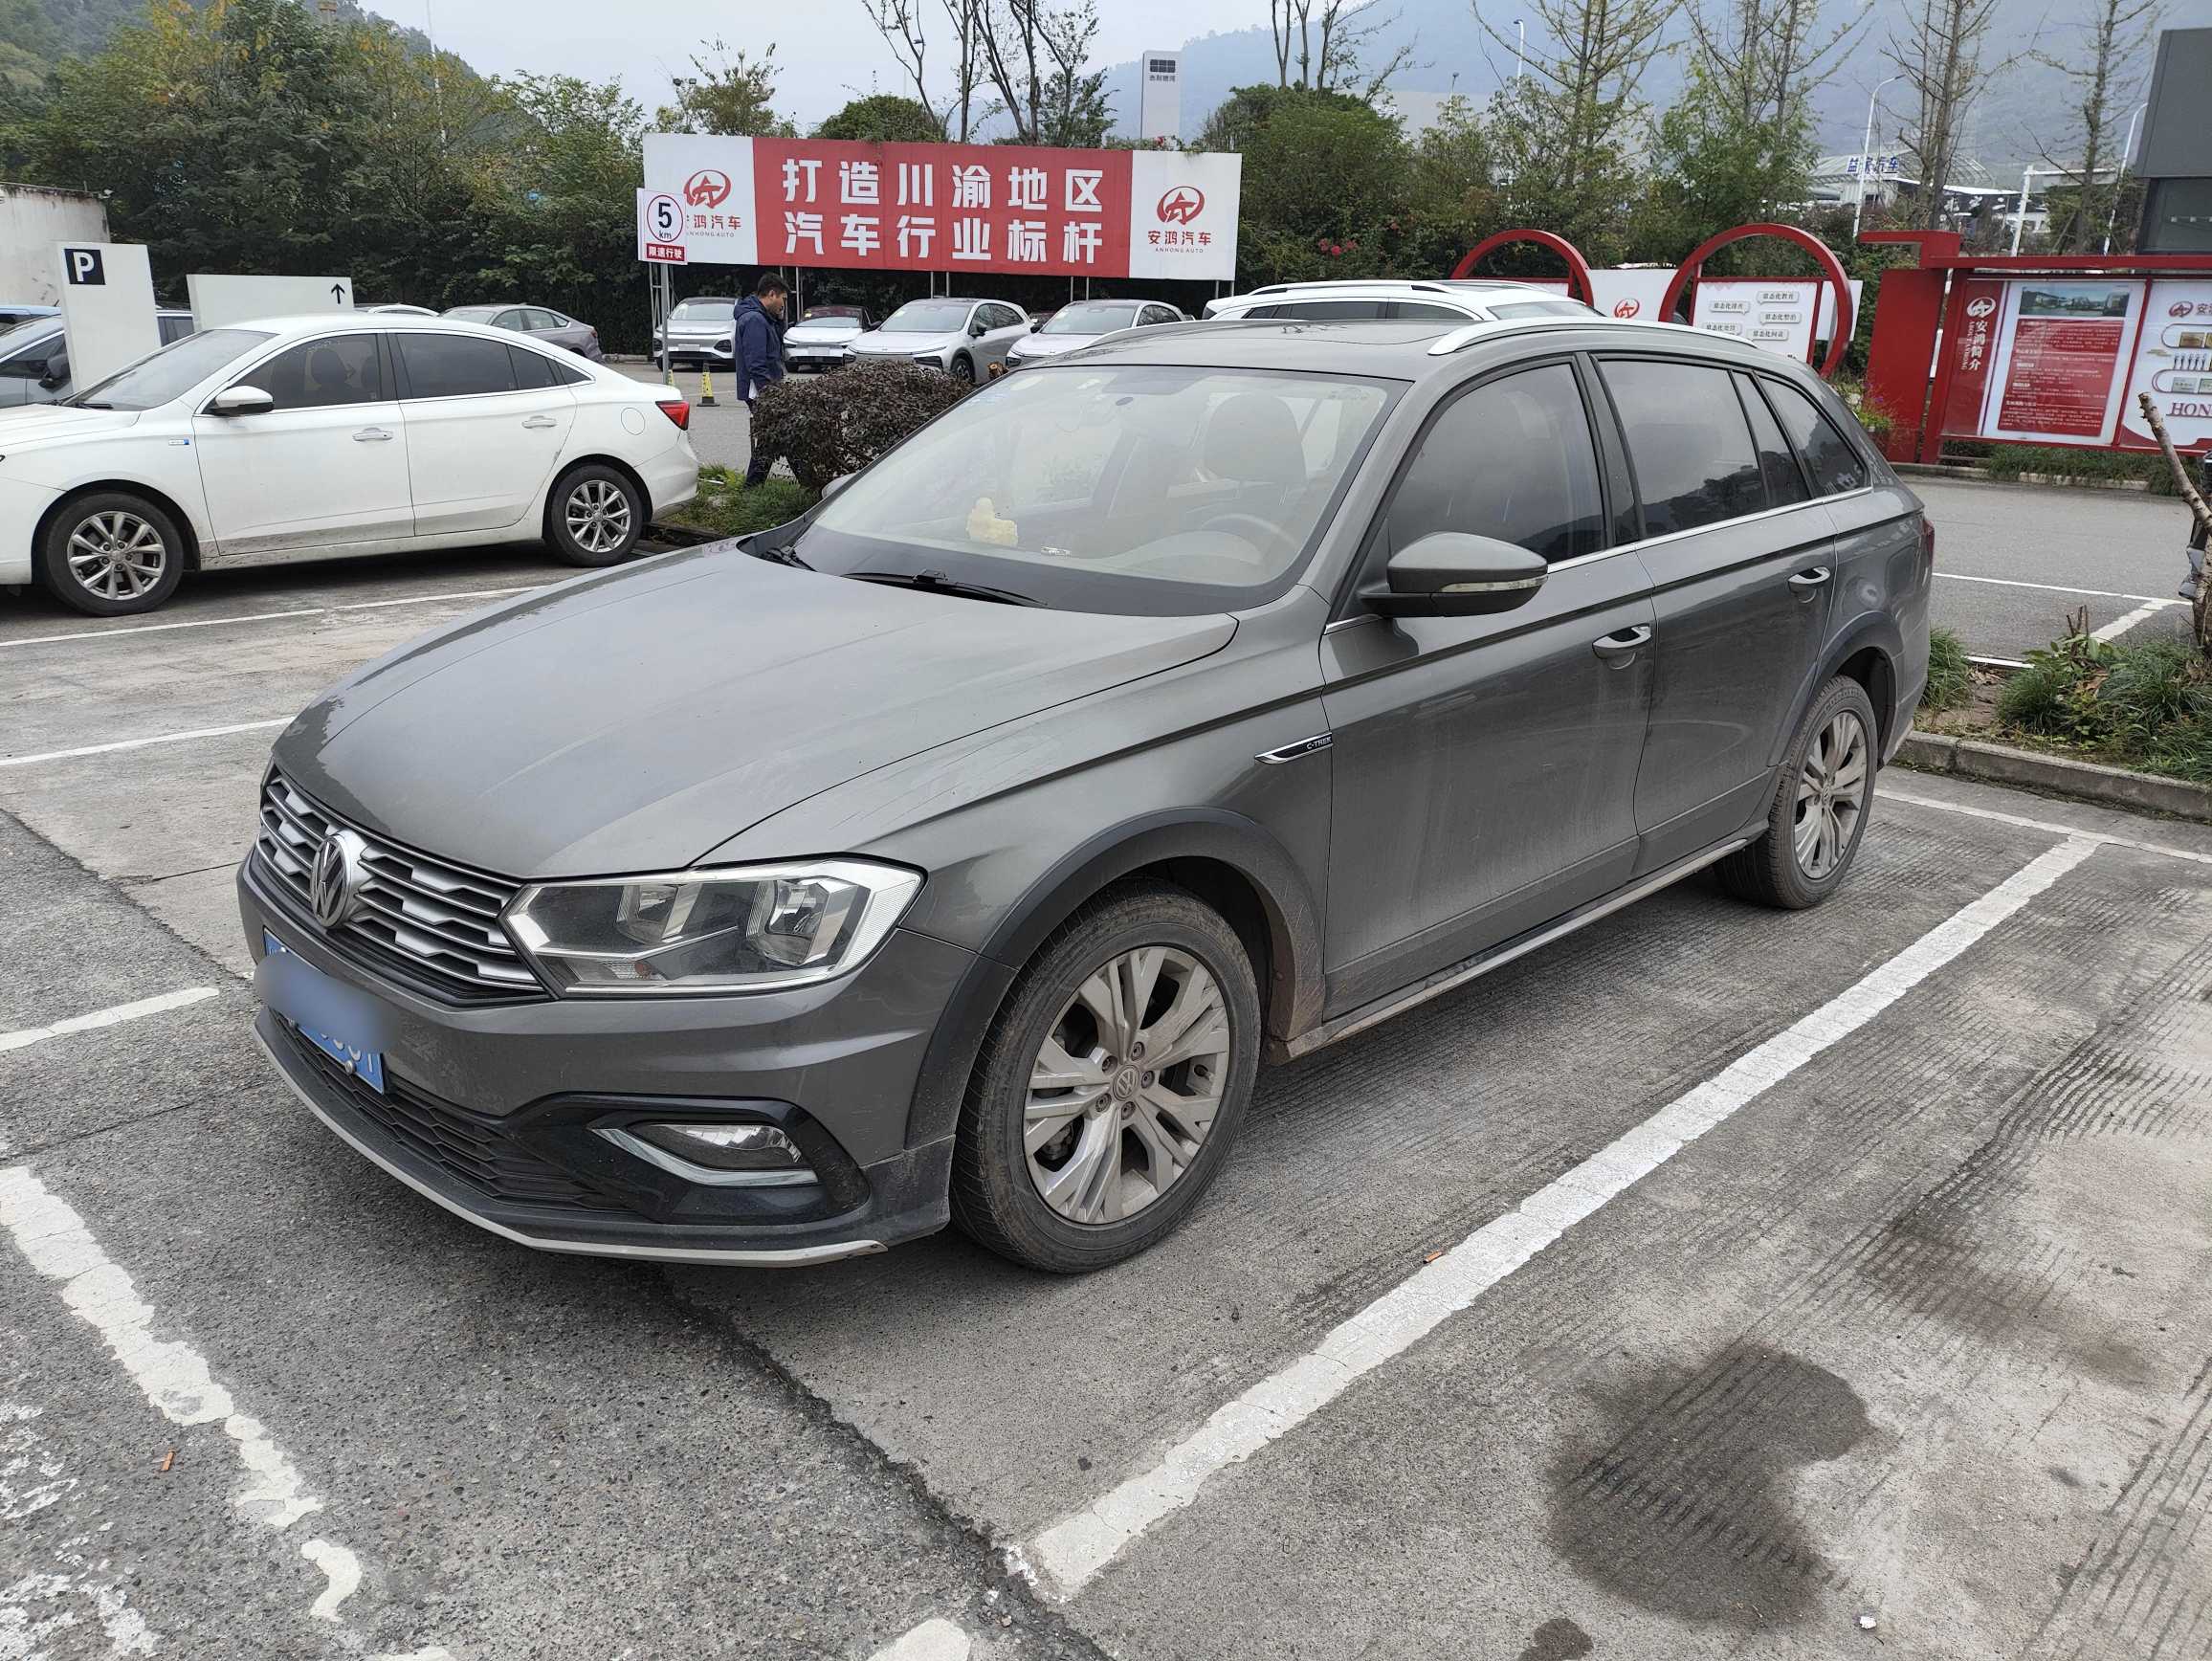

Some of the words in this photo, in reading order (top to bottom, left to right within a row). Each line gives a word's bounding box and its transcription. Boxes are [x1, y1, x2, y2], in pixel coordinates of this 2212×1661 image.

[782, 158, 1103, 212] 打造川渝地区
[657, 202, 673, 229] 5
[687, 214, 741, 231] 鸿汽车
[658, 231, 673, 239] km
[784, 210, 1103, 264] 汽车行业标杆
[1147, 230, 1212, 246] 安鸿汽车
[73, 251, 95, 282] P
